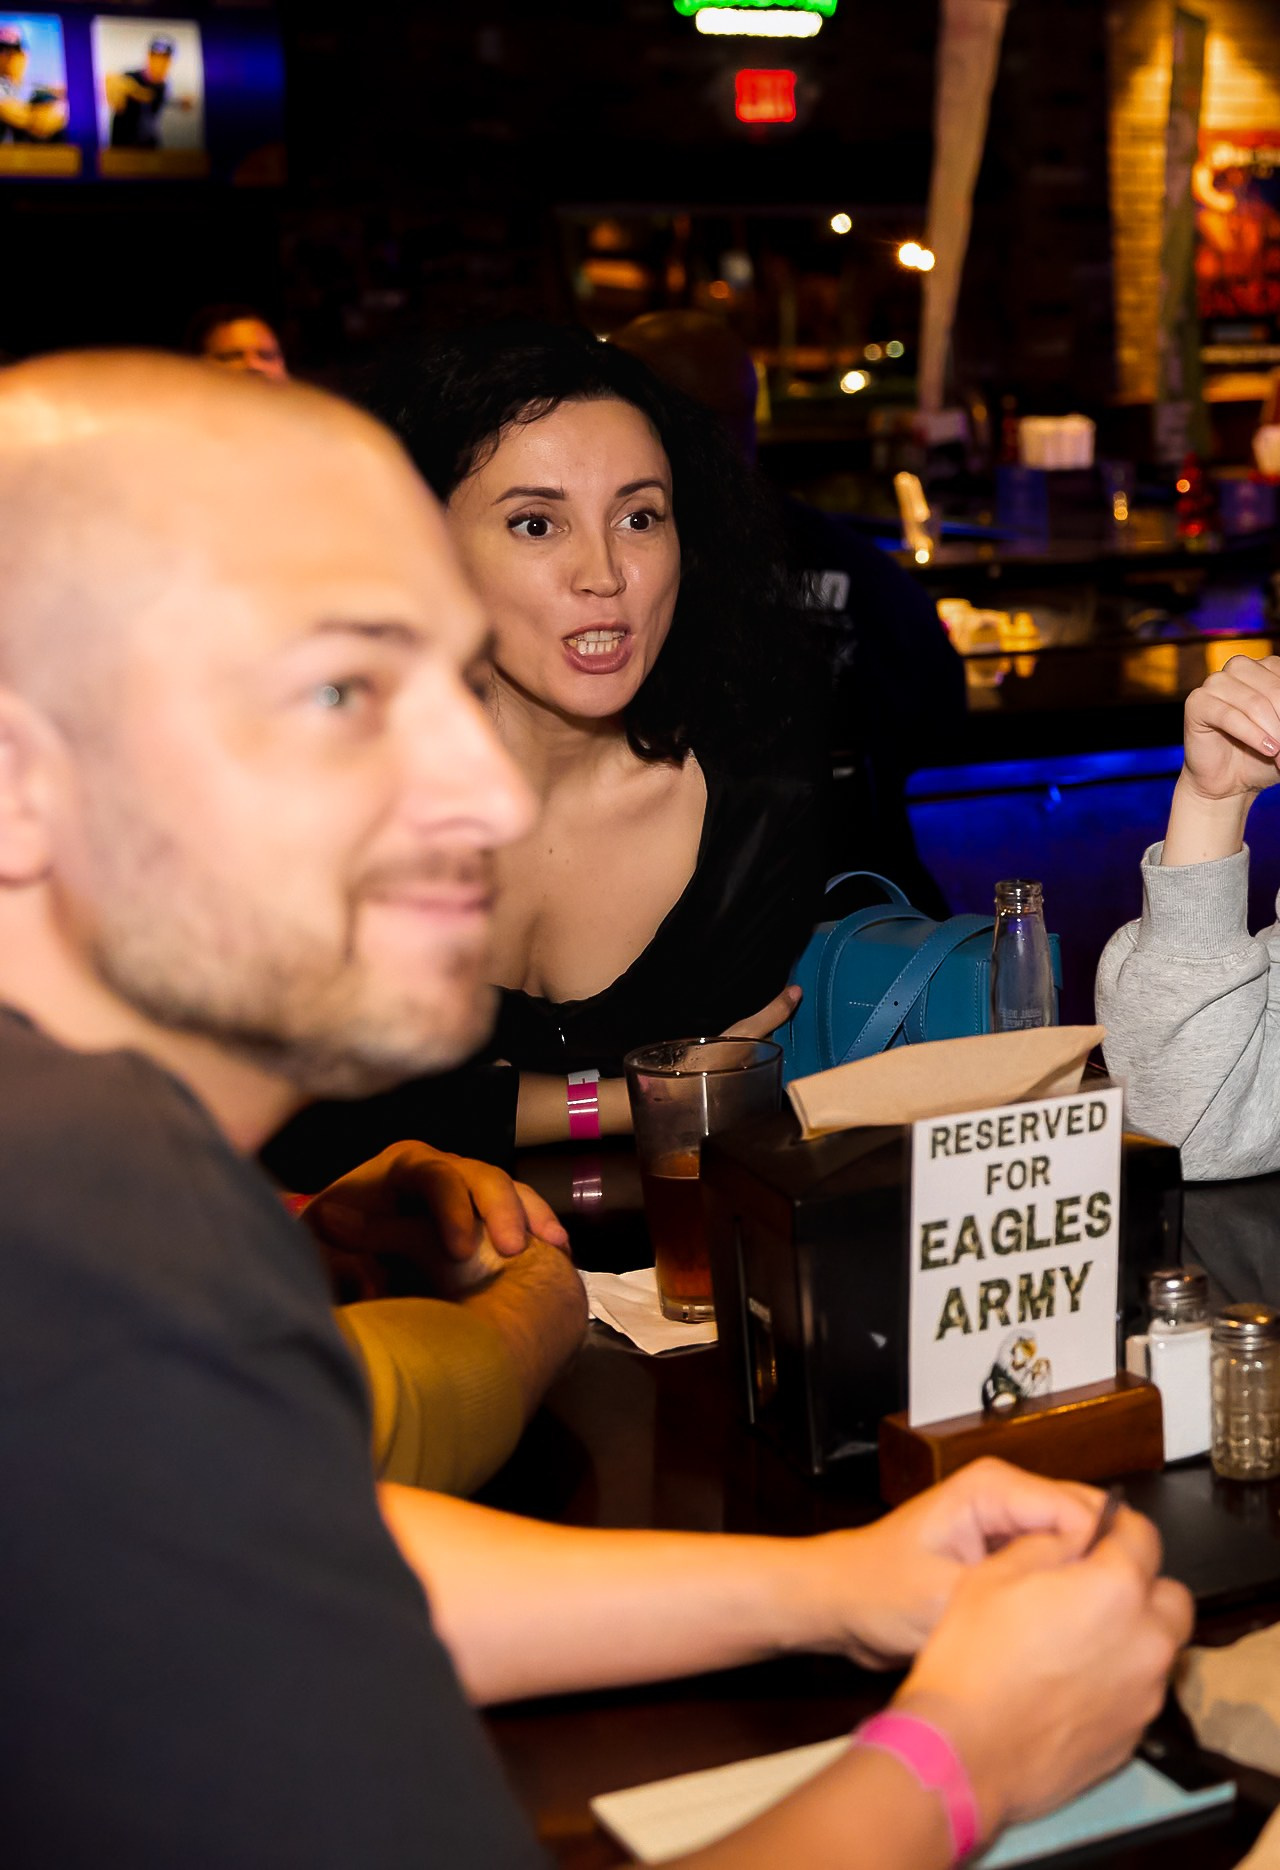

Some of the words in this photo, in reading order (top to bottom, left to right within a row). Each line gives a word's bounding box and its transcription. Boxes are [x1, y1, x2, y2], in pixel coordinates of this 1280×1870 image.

[930, 1101, 1107, 1159] RESERVED
[985, 1155, 1051, 1196] FOR
[920, 1191, 1111, 1272] EAGLES
[935, 1260, 1093, 1341] ARMY
